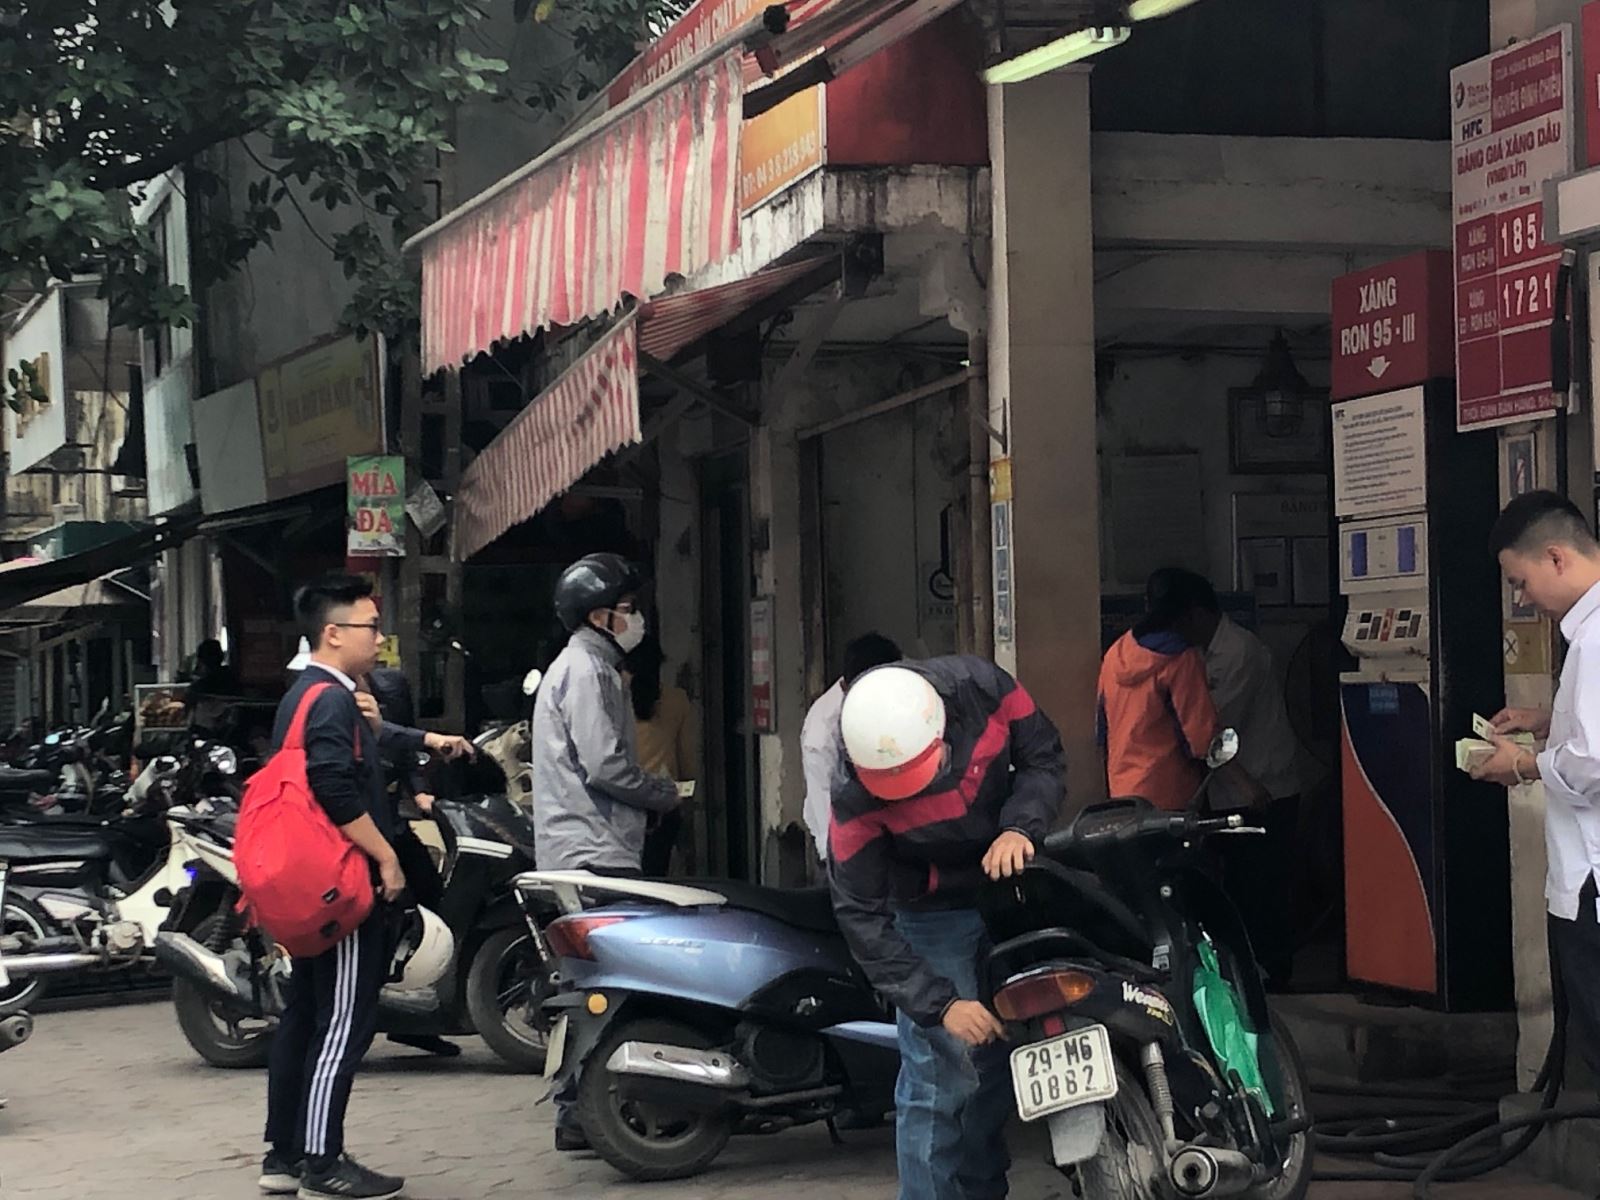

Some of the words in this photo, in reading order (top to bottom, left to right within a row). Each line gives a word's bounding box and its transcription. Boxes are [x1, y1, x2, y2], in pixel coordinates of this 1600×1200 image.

[1457, 148, 1484, 176] BẢNG
[1486, 137, 1504, 165] GIÁ
[1505, 131, 1535, 159] XĂNG
[1538, 116, 1561, 148] DẦU
[1502, 213, 1544, 257] 185
[1359, 276, 1397, 314] XĂNG
[1341, 322, 1370, 356] RON
[1373, 317, 1392, 349] 95
[1402, 312, 1415, 343] III
[1025, 1034, 1093, 1078] 29-M6
[1030, 1064, 1097, 1106] 0882
